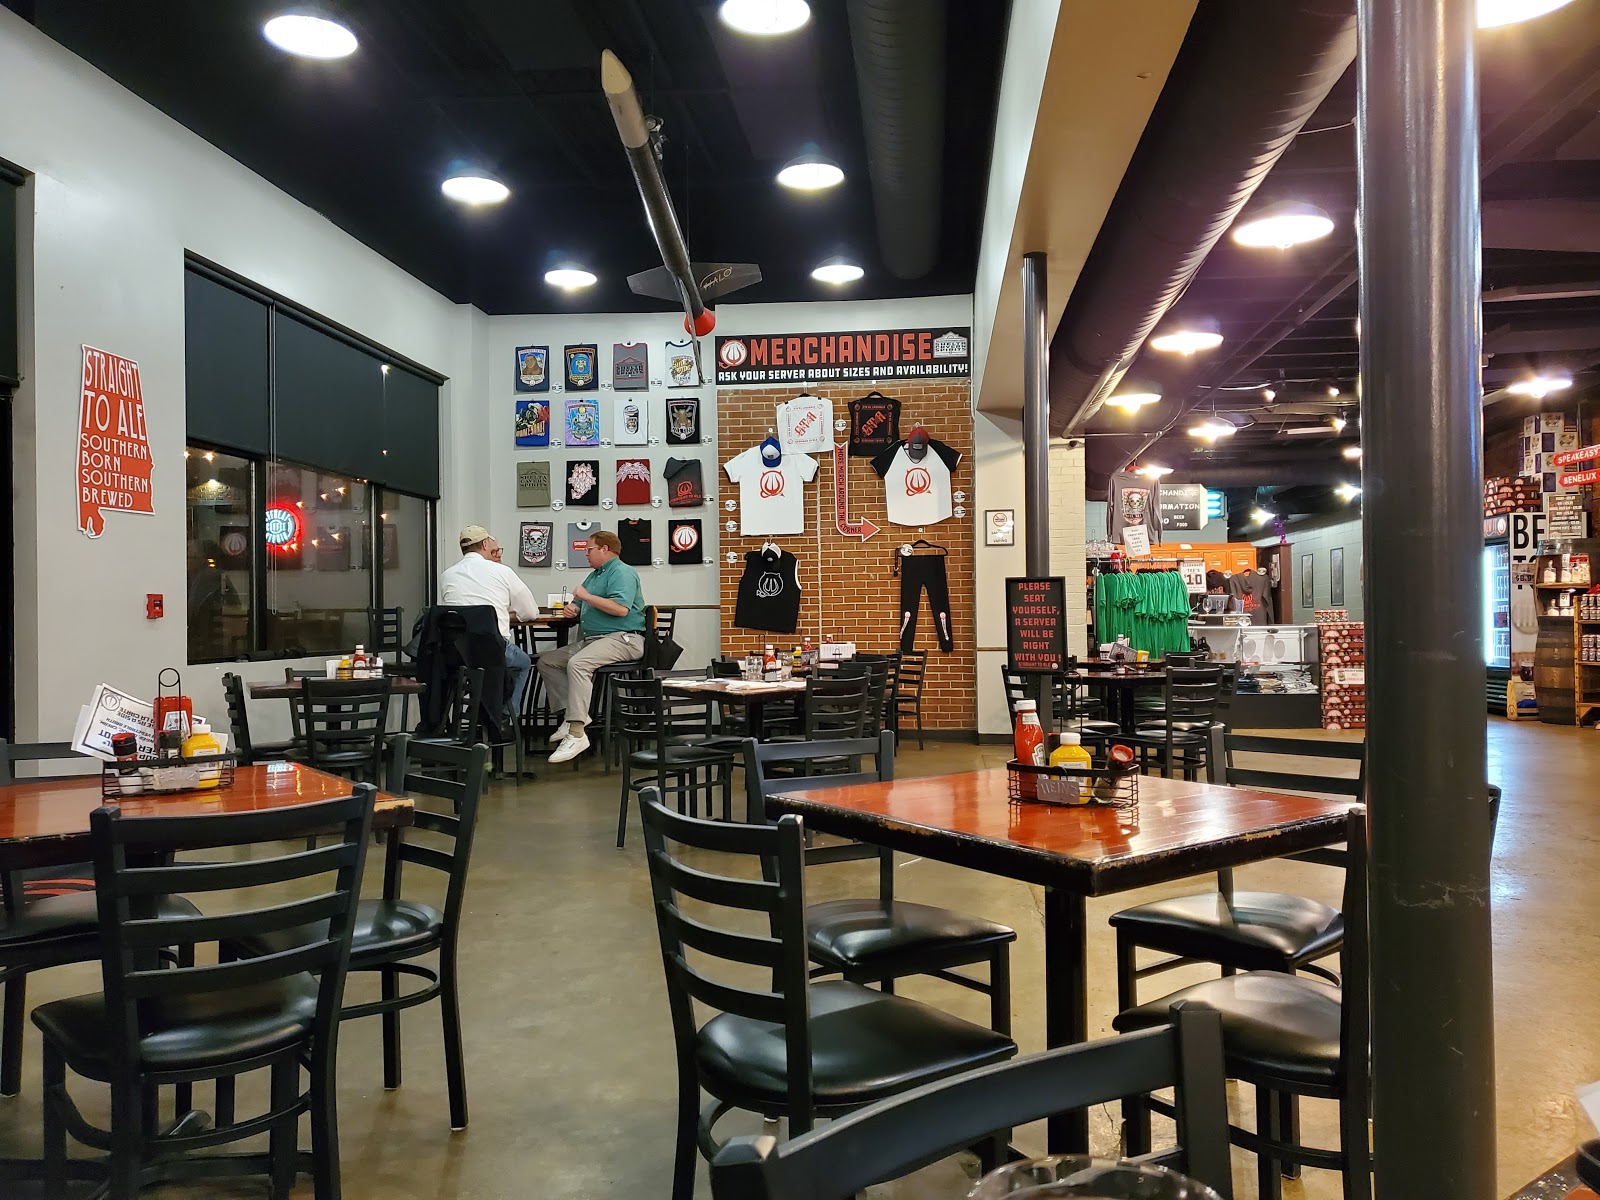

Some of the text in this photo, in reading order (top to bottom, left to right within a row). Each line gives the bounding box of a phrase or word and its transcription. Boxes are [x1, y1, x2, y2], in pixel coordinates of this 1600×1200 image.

[750, 332, 932, 366] MERCHANDISE
[85, 350, 141, 400] STRAIGHT
[718, 364, 968, 381] ASK YOUR SERVER ABOUT SIZES AND AVAILABILITY!
[84, 390, 146, 441] TO ALE
[82, 433, 148, 460] SOUTHERN
[1558, 448, 1598, 464] SPEAKEASY
[82, 450, 121, 472] BORN
[82, 468, 148, 494] SOUTHERN
[1564, 472, 1597, 484] BENELUX
[82, 486, 132, 508] BREWED
[840, 523, 862, 534] CORNER
[1018, 583, 1050, 591] PLEASE
[1184, 574, 1202, 585] $10
[1012, 606, 1060, 615] YOURSELF,
